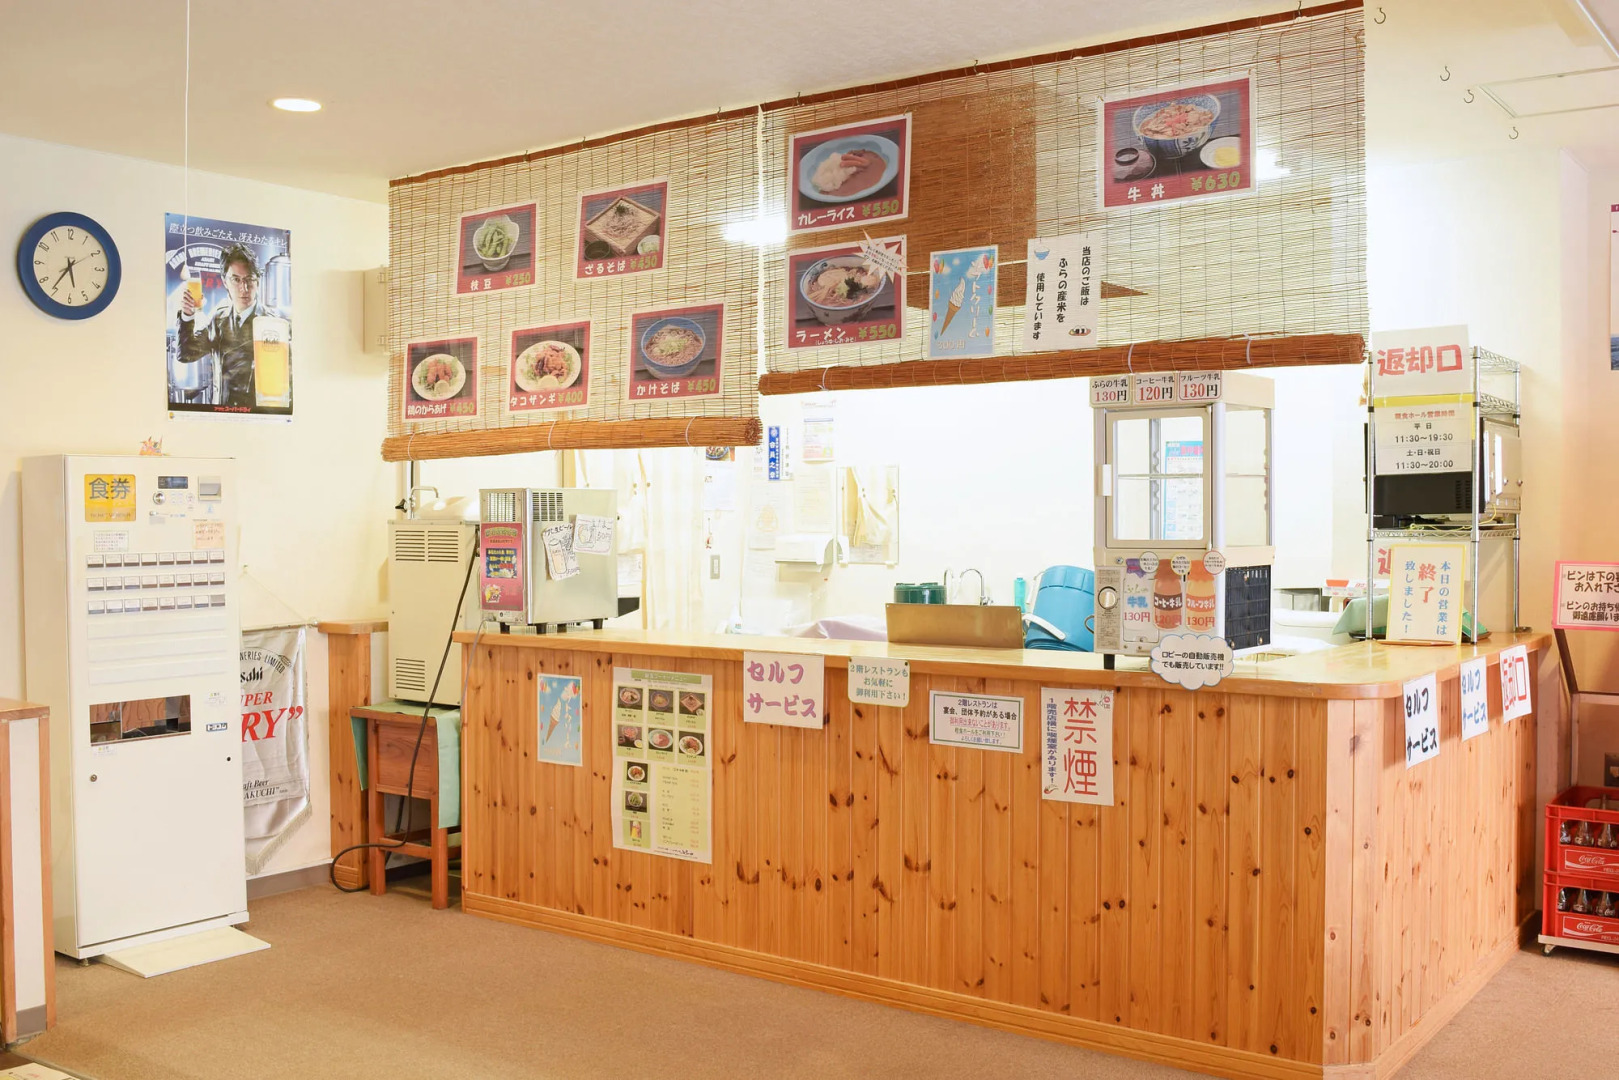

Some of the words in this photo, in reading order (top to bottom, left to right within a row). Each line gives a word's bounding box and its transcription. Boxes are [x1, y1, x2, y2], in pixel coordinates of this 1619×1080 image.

[1127, 183, 1165, 202] 牛丼
[1191, 171, 1240, 191] ¥630
[798, 207, 854, 226] カレーライス
[862, 200, 900, 218] ¥550
[51, 230, 59, 243] 11
[67, 228, 74, 240] 12
[82, 235, 88, 245] 1
[38, 242, 50, 252] 10
[584, 260, 626, 275] ざるそば
[39, 276, 49, 284] 8
[470, 278, 492, 291] 枝豆
[506, 272, 531, 286] ¥250
[1080, 246, 1091, 306] 当店のご飯は
[92, 281, 101, 289] 4
[1056, 258, 1068, 323] ふらの産米を
[67, 293, 72, 304] 6
[81, 290, 88, 301] 5
[1032, 272, 1045, 340] 使用しています
[796, 328, 846, 343] ラーメン
[858, 323, 896, 340] ¥550
[1377, 344, 1463, 376] 返却口
[1092, 379, 1128, 388] ふらの牛乳
[1136, 376, 1175, 385] コーヒー牛乳
[1180, 373, 1221, 383] フルーツ牛乳
[636, 382, 680, 396] かけそば
[687, 378, 716, 392] ¥450
[1139, 386, 1174, 401] 120円
[1183, 383, 1218, 398] 130円
[510, 392, 556, 407] タコザンギ
[1095, 389, 1127, 402] 130円
[407, 403, 447, 416] 鶏のからあげ
[1414, 422, 1432, 430] 平日
[88, 477, 130, 500] 食券
[1418, 563, 1437, 604] 終了
[1127, 596, 1148, 608] 牛乳
[1154, 596, 1182, 608] コーヒー牛乳
[1402, 560, 1416, 634] 致しました!
[1436, 560, 1451, 636] 本日の営業は
[1124, 612, 1150, 622] 130円
[1187, 616, 1216, 627] 130円
[1162, 651, 1225, 661] ロビーの自動販売機
[746, 660, 804, 684] セルフ
[864, 678, 893, 688] お気軽に
[1462, 669, 1480, 695] セルフ
[746, 693, 816, 718] サービス
[958, 699, 998, 709] 2階レストランは
[1406, 687, 1429, 718] セルフ
[943, 706, 1017, 720] 宴会、団体予約がある場合
[1463, 702, 1486, 730] サービス
[1064, 697, 1098, 796] 禁煙
[1406, 727, 1438, 761] サービス
